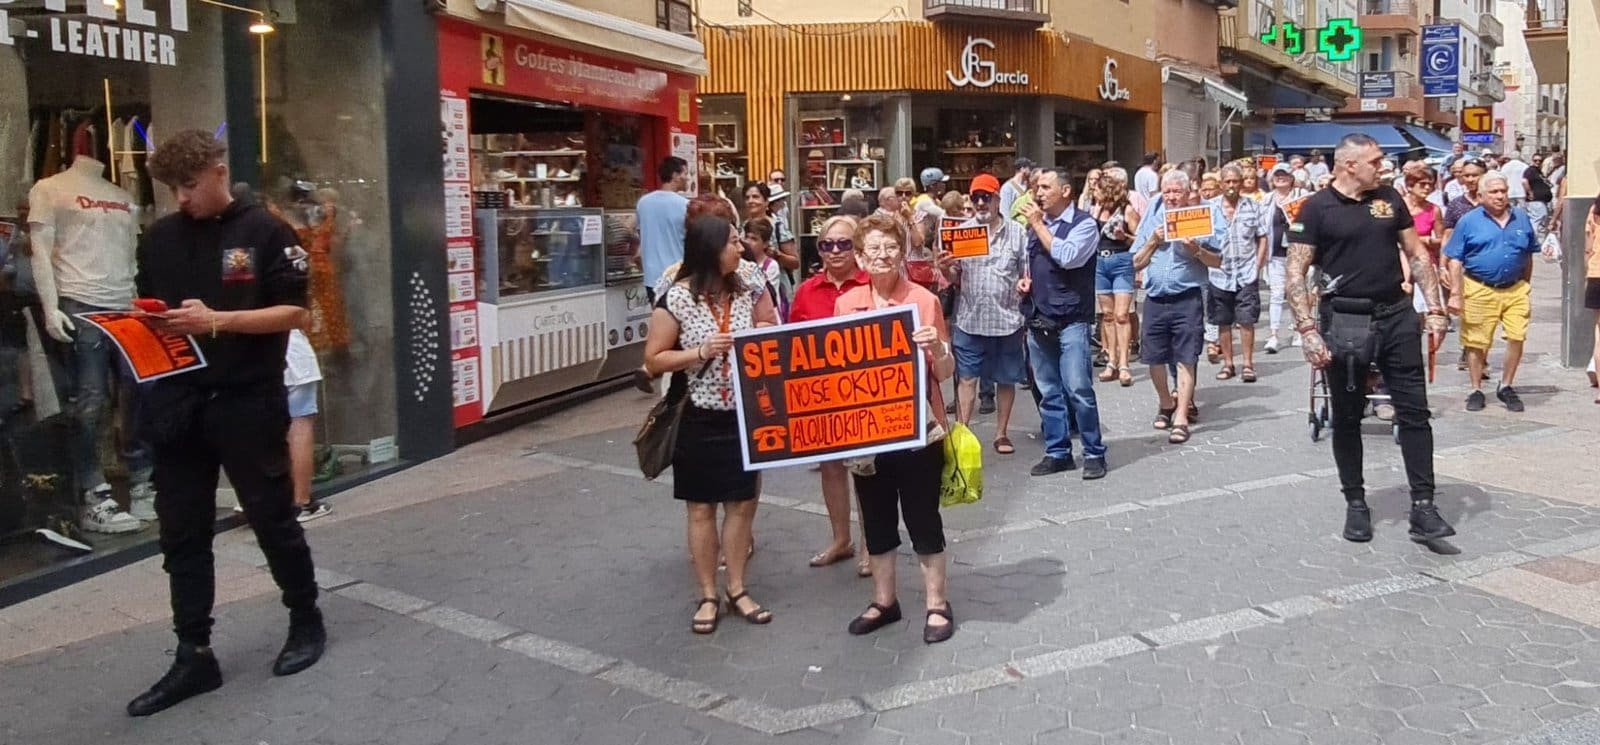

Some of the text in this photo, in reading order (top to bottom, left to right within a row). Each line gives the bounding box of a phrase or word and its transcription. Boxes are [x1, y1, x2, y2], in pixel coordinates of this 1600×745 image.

[51, 17, 176, 66] LEATHER
[1166, 207, 1210, 223] SE ALQUILA
[942, 227, 987, 241] SE ALQUILA
[743, 319, 911, 378] SE ALQUILA
[837, 365, 910, 402] OKUPA
